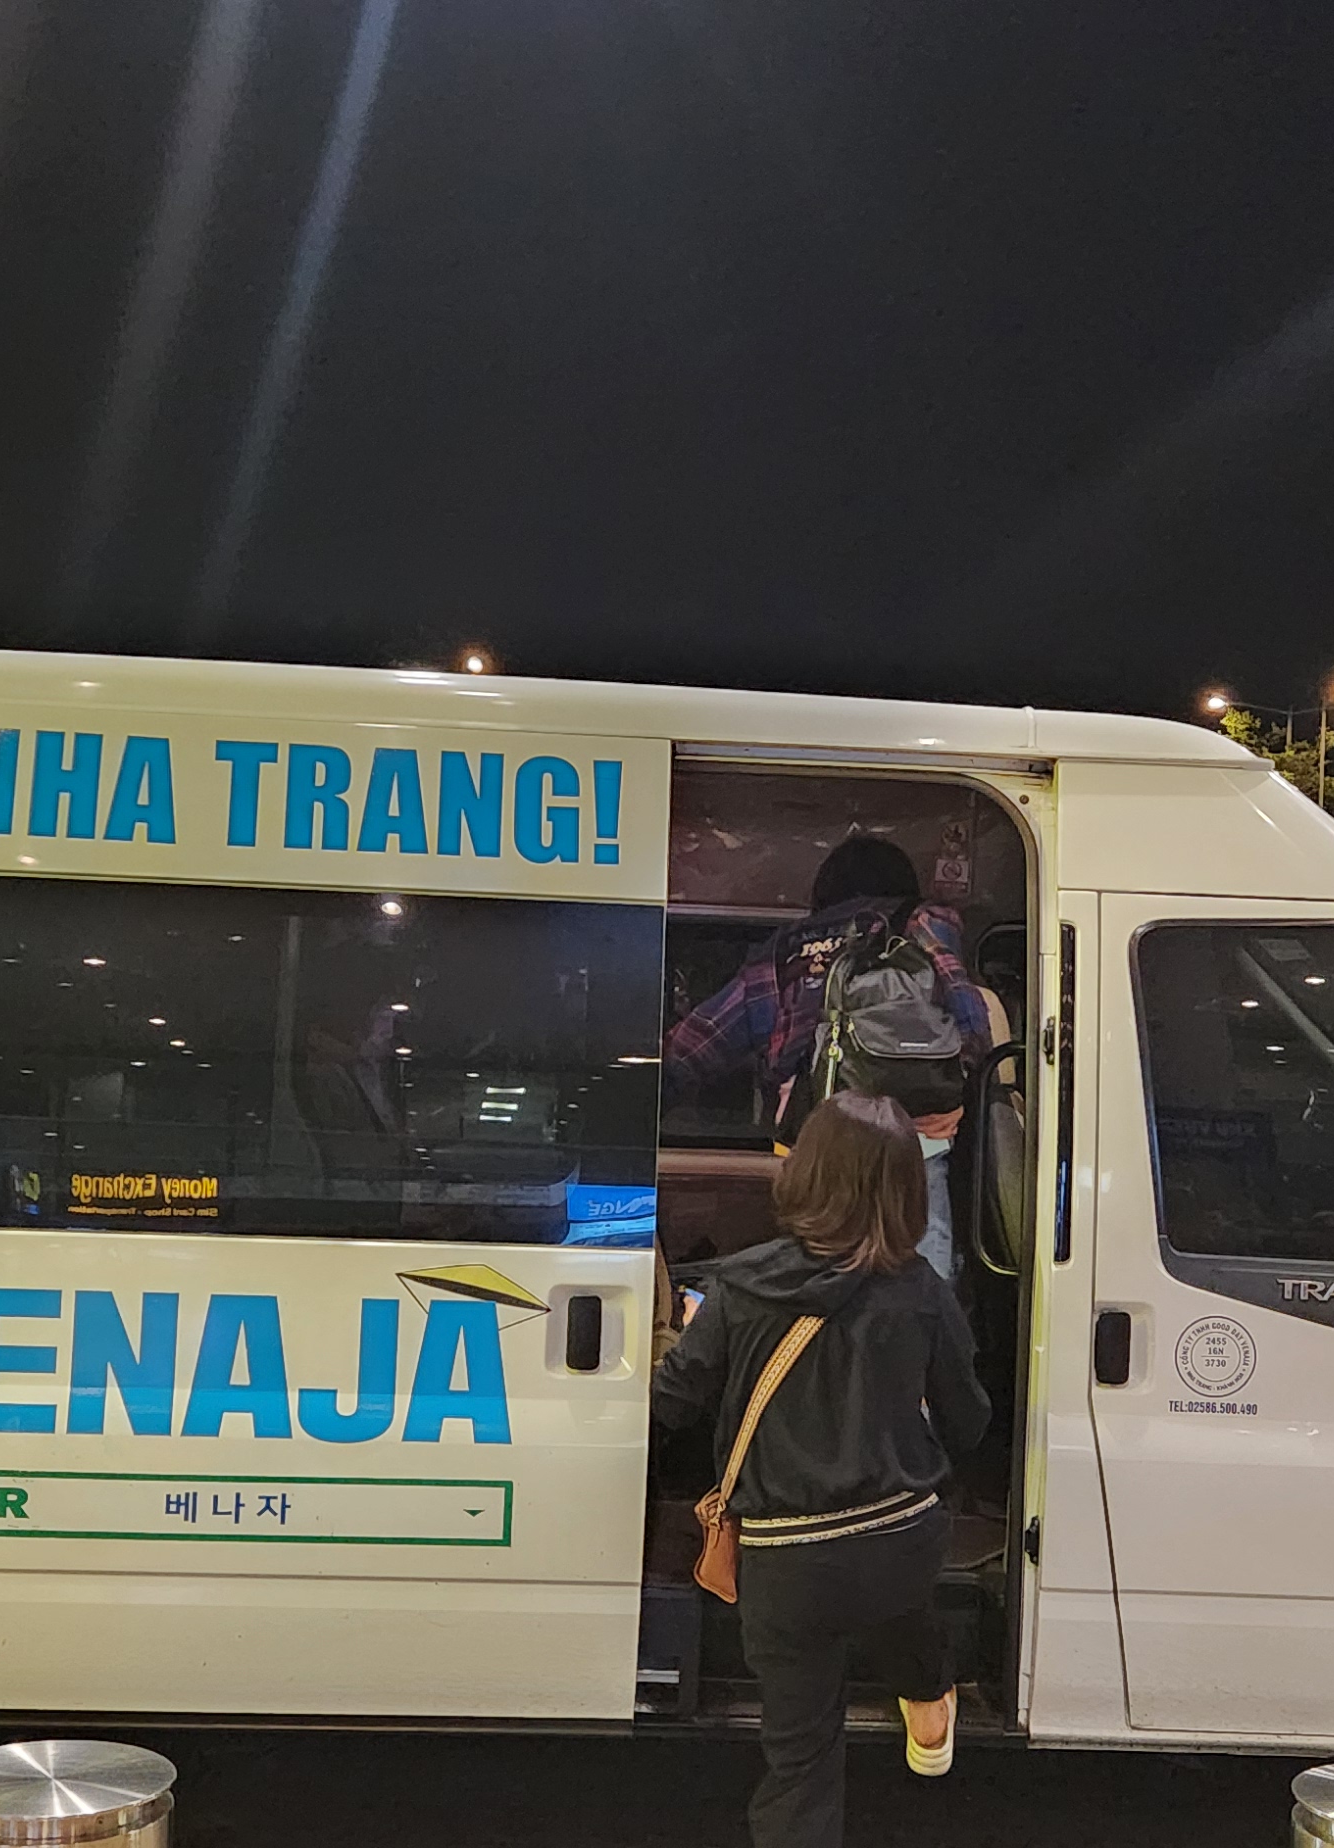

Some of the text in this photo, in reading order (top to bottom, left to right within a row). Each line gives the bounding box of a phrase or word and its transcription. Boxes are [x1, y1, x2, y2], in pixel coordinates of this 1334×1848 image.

[214, 740, 624, 865] TRANG!
[1211, 1322, 1231, 1332] GOOD
[1205, 1336, 1227, 1346] 2455
[1207, 1347, 1225, 1355] 16N
[1204, 1358, 1227, 1368] 3730
[1168, 1400, 1258, 1415] TEL:02586.500.490
